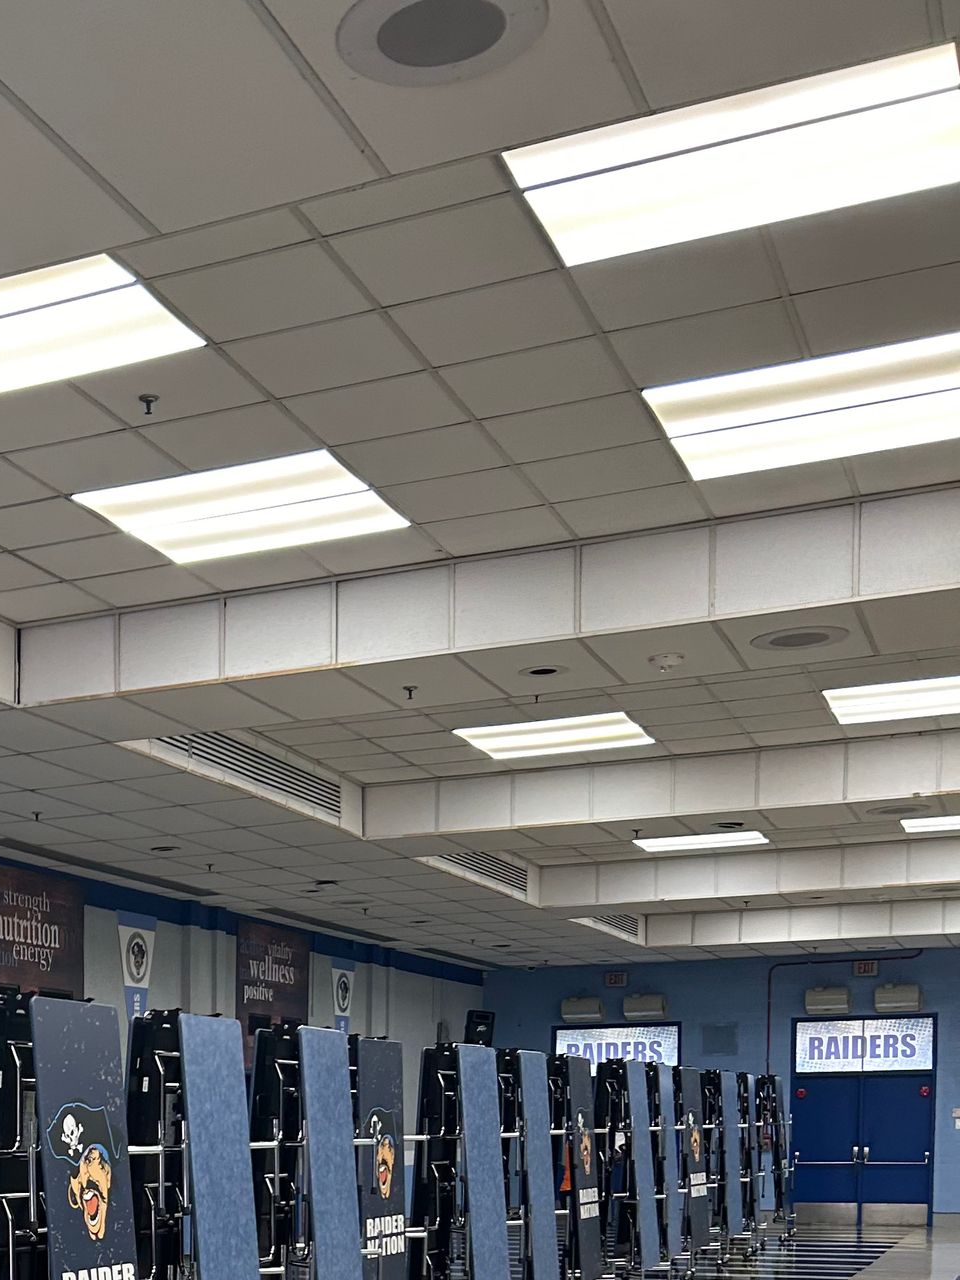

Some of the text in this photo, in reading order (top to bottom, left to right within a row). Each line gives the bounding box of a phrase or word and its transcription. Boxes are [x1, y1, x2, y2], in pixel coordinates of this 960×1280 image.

[3, 887, 51, 914] strength
[13, 943, 54, 971] energy
[249, 955, 294, 985] wellness
[243, 981, 273, 1004] positive
[809, 1034, 916, 1060] RAIDERS
[366, 1215, 404, 1237] RAIDER
